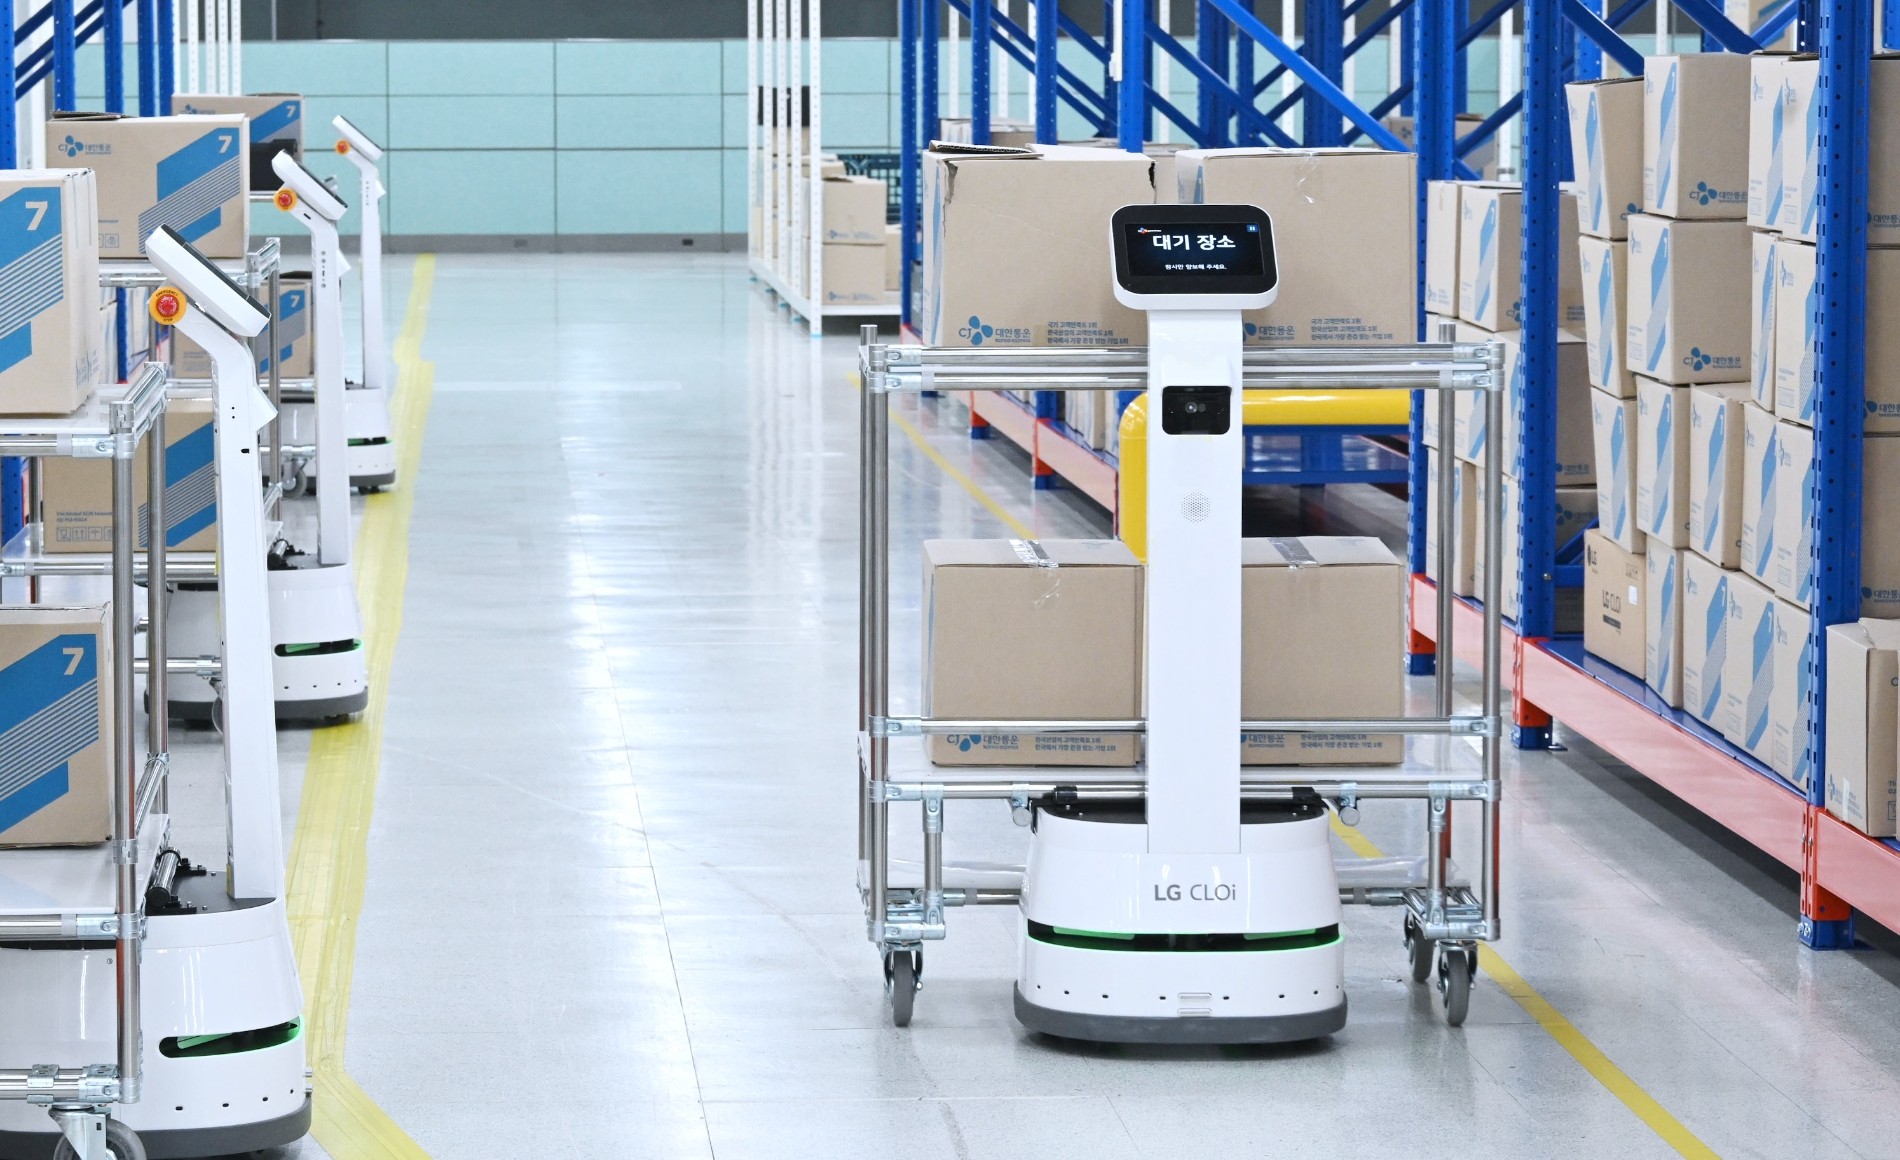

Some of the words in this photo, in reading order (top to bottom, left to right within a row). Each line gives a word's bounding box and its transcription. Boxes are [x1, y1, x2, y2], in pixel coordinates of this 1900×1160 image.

[286, 105, 297, 118] 7
[218, 135, 233, 154] 7
[1689, 191, 1701, 201] CJ
[25, 201, 50, 231] 7
[1873, 214, 1900, 223] 대한통
[1152, 234, 1191, 251] 대기
[1196, 234, 1236, 251] 장소
[958, 327, 972, 339] CJ
[995, 328, 1031, 338] 대한통운
[1258, 326, 1295, 336] 대한통운
[1683, 357, 1694, 367] CJ
[1712, 356, 1741, 365] 대한통운
[63, 647, 85, 676] 7
[946, 734, 960, 745] CJ
[983, 735, 1019, 745] 대한통운
[1154, 884, 1181, 901] LG
[1190, 884, 1236, 901] CLOi
